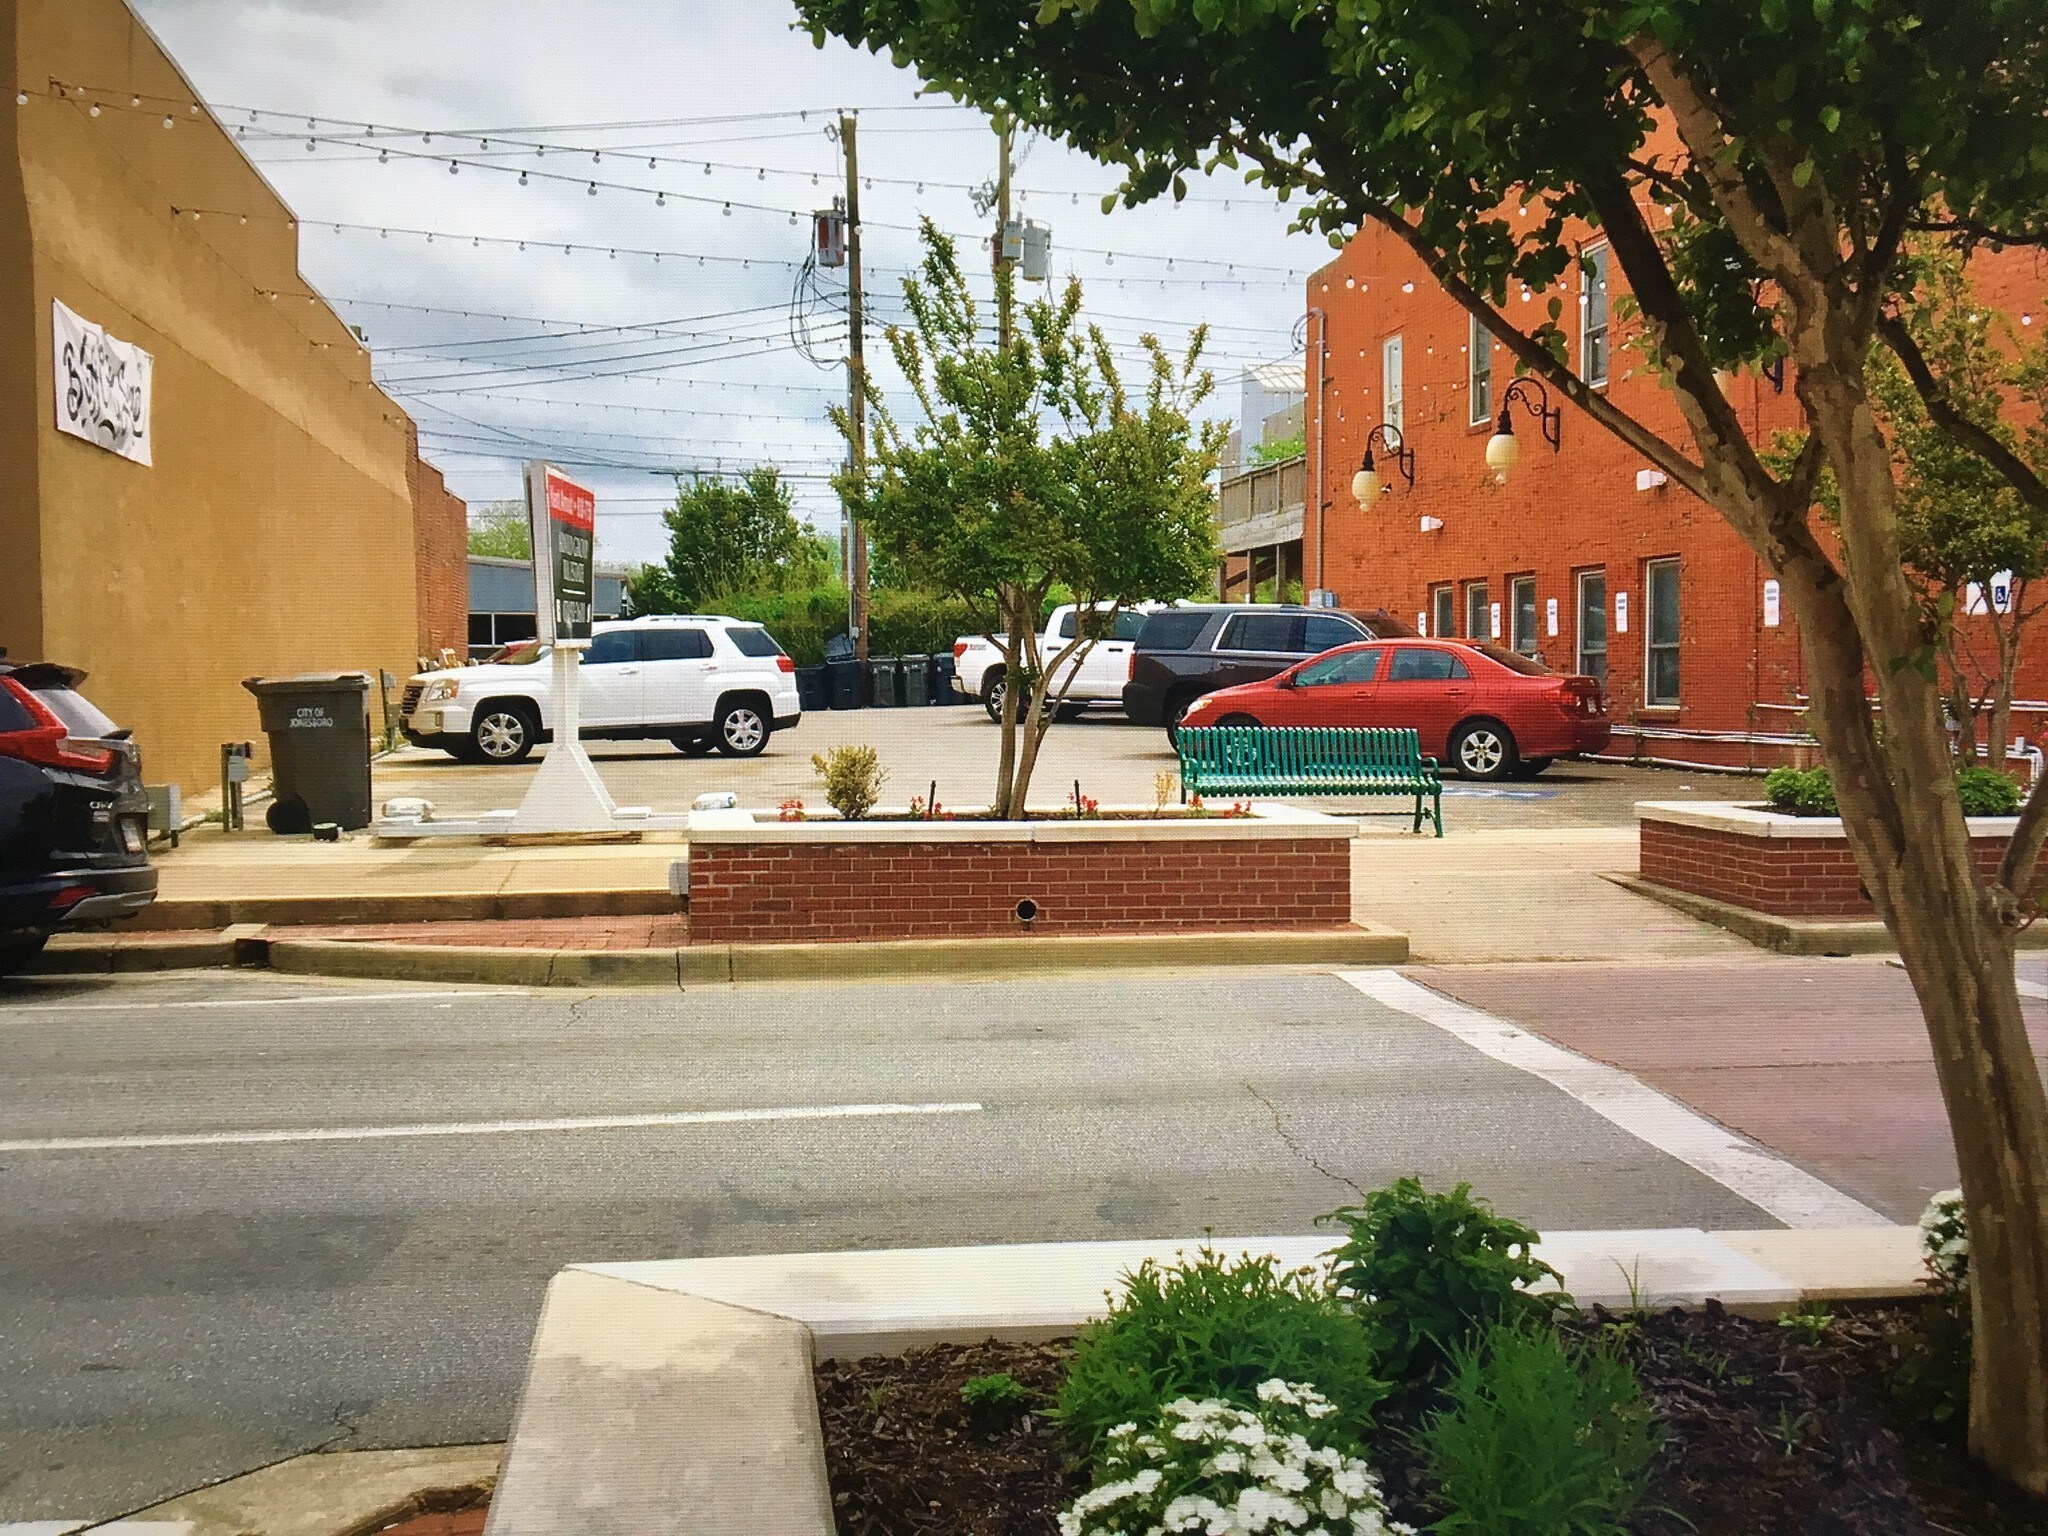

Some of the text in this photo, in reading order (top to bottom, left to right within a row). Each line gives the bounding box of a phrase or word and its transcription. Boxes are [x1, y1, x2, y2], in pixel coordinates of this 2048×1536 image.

[296, 707, 325, 717] CITY OF
[289, 717, 334, 728] JONESBORO
